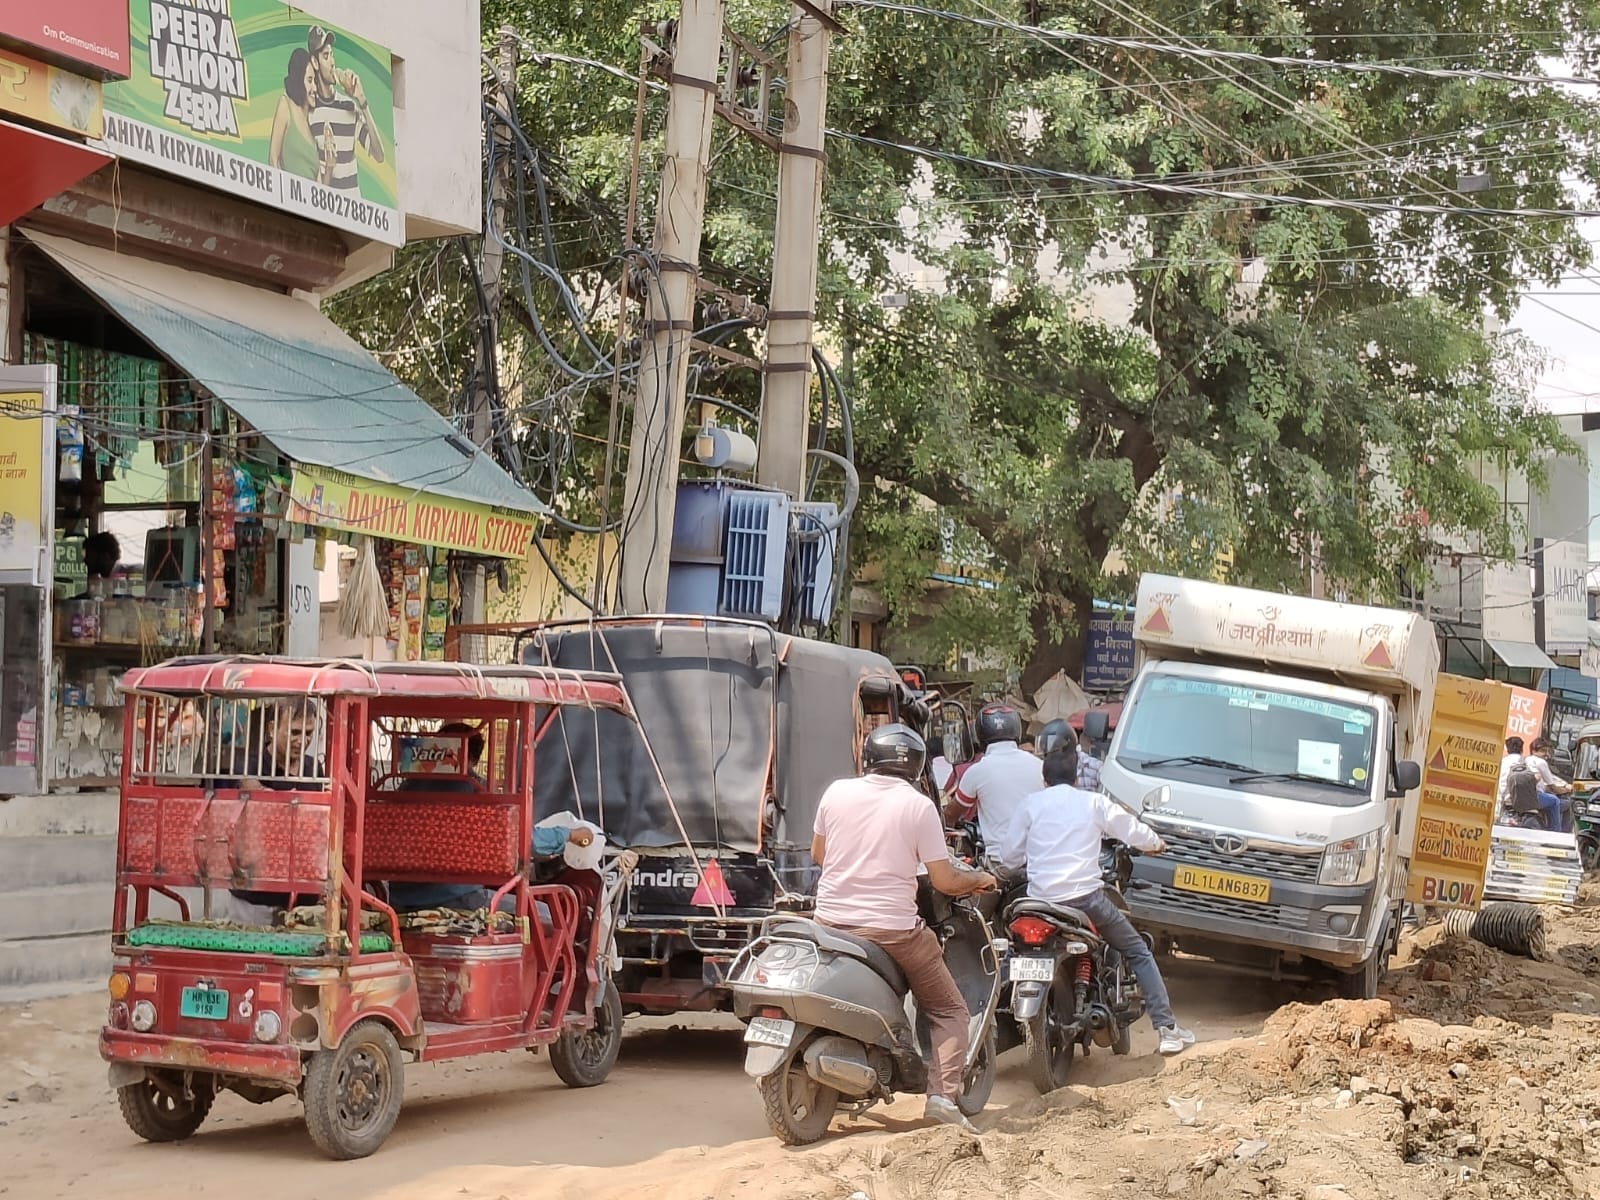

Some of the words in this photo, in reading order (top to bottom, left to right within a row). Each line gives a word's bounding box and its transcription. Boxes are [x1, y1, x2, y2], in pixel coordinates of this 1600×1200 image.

[43, 25, 58, 39] Om
[59, 30, 119, 60] Communication
[150, 2, 239, 58] PEERA
[149, 38, 246, 97] LAHORI
[164, 79, 239, 136] ZEERA
[159, 133, 226, 177] KIRYANA
[229, 158, 273, 193] STORE
[310, 185, 390, 232] 8802788766
[345, 489, 408, 536] DAHIYA
[412, 502, 480, 548] KIRYANA
[482, 516, 533, 556] STORE
[411, 746, 446, 761] Yatri
